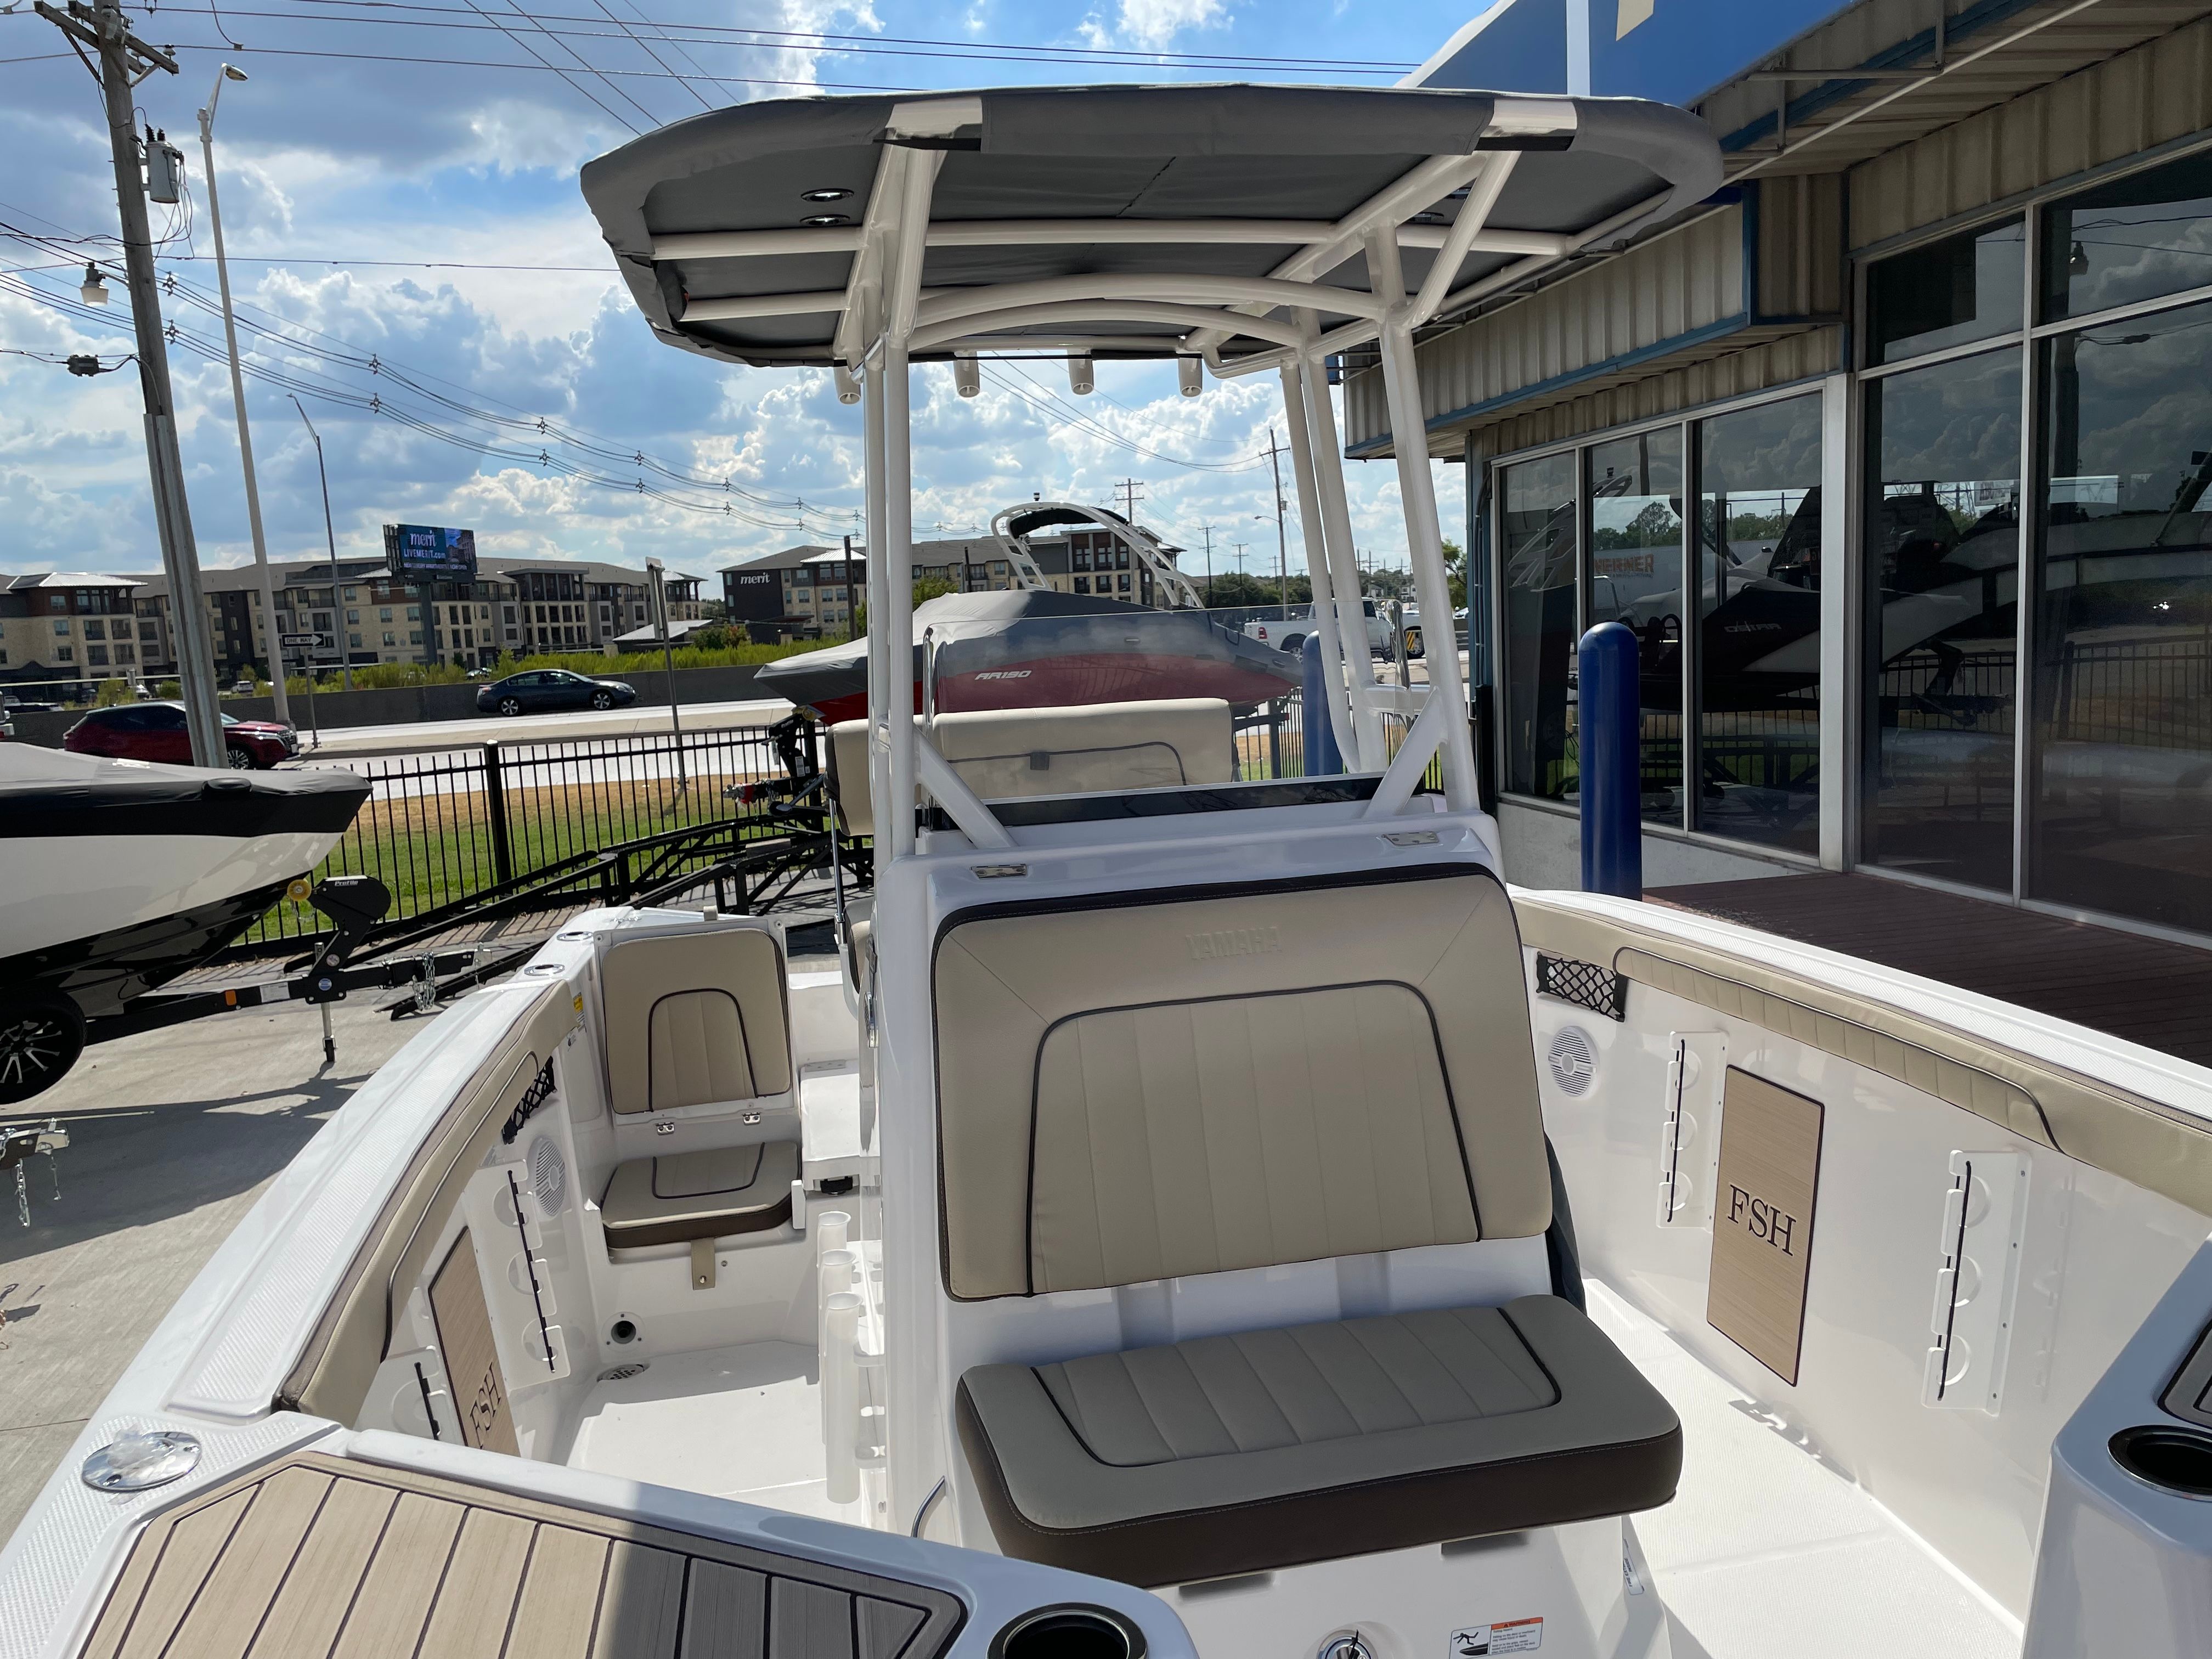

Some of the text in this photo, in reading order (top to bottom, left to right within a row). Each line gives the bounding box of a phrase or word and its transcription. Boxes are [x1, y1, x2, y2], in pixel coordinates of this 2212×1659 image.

[410, 530, 437, 547] merit
[403, 549, 446, 559] LIVEMERIT.com
[740, 572, 770, 584] merit
[974, 670, 1032, 680] AR190
[1185, 926, 1283, 960] YAMAHA
[1728, 1183, 1797, 1256] FSH
[470, 1362, 501, 1449] FSH
